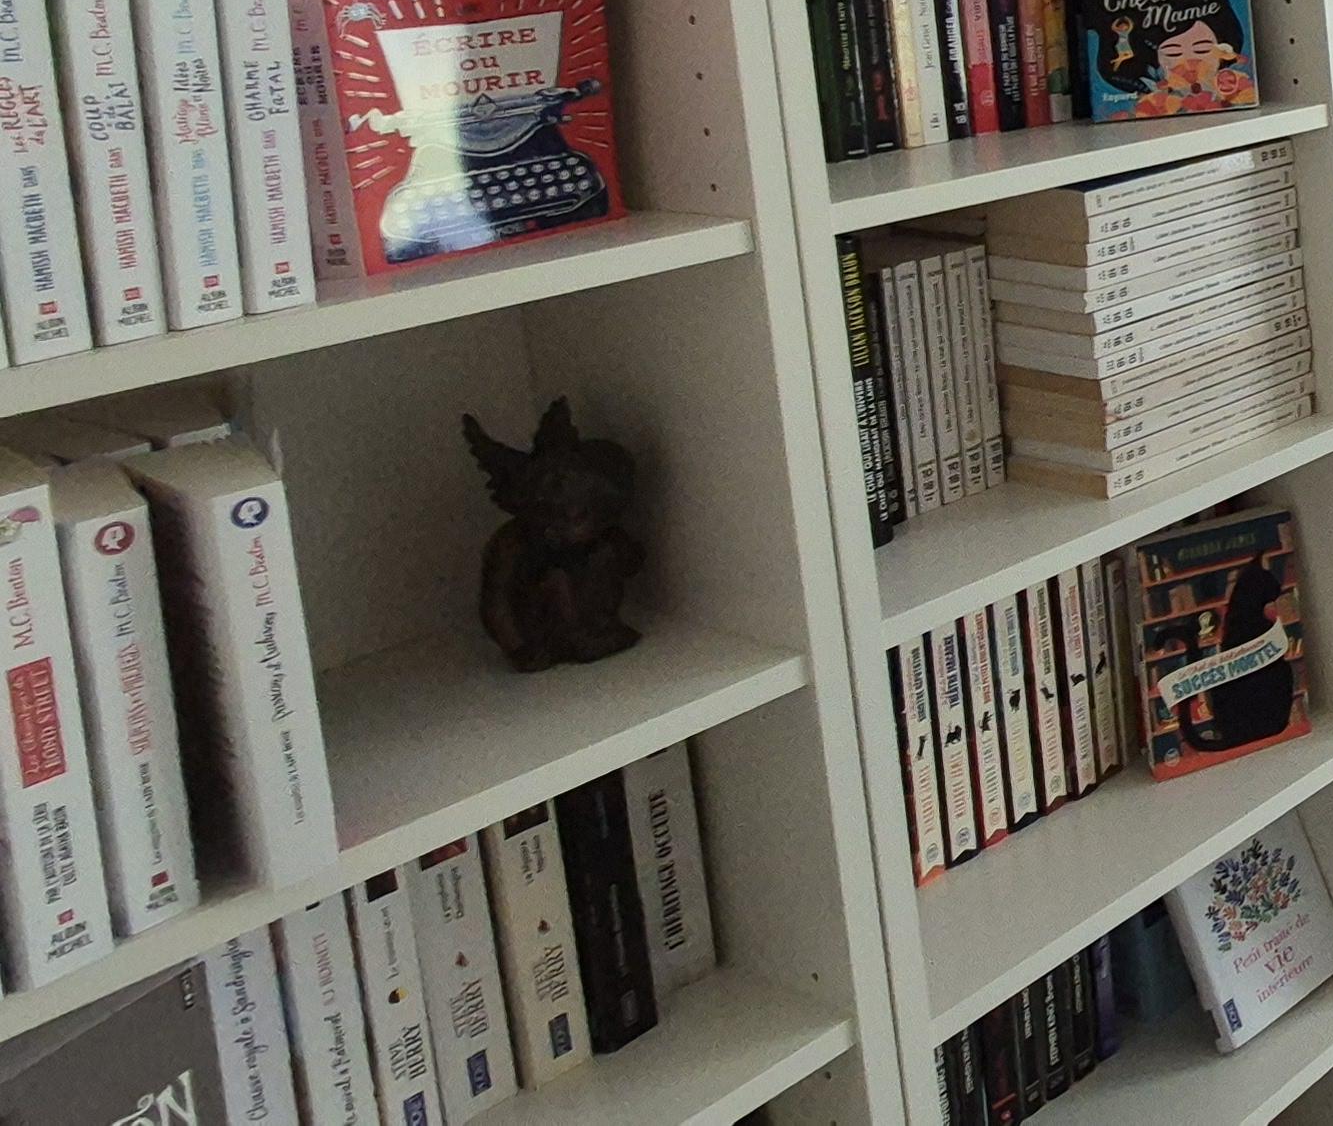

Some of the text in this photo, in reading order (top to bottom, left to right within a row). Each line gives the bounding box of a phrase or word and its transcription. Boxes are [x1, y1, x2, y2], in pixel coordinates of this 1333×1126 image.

[411, 28, 539, 56] ÉCRIRE
[1142, 1, 1221, 32] Mamie
[419, 69, 546, 100] MOURIR
[82, 95, 109, 142] COUP
[108, 173, 139, 270] HAMISH MACBETH
[192, 175, 219, 268] HAMISH MACBETH
[261, 154, 288, 245] HAMISH MACBETH
[22, 191, 56, 292] HAMISH MACBETH
[842, 252, 870, 368] LILIAN JACKSON BRAUN
[247, 535, 269, 575] Beaton
[4, 556, 29, 610] Beaton
[107, 561, 133, 606] Beaton
[10, 612, 36, 650] M.C.
[221, 938, 256, 1016] Sandringha
[545, 944, 569, 1001] BERRY
[1264, 946, 1294, 974] vie
[464, 978, 490, 1038] BERRY
[400, 1023, 428, 1080] BERRY
